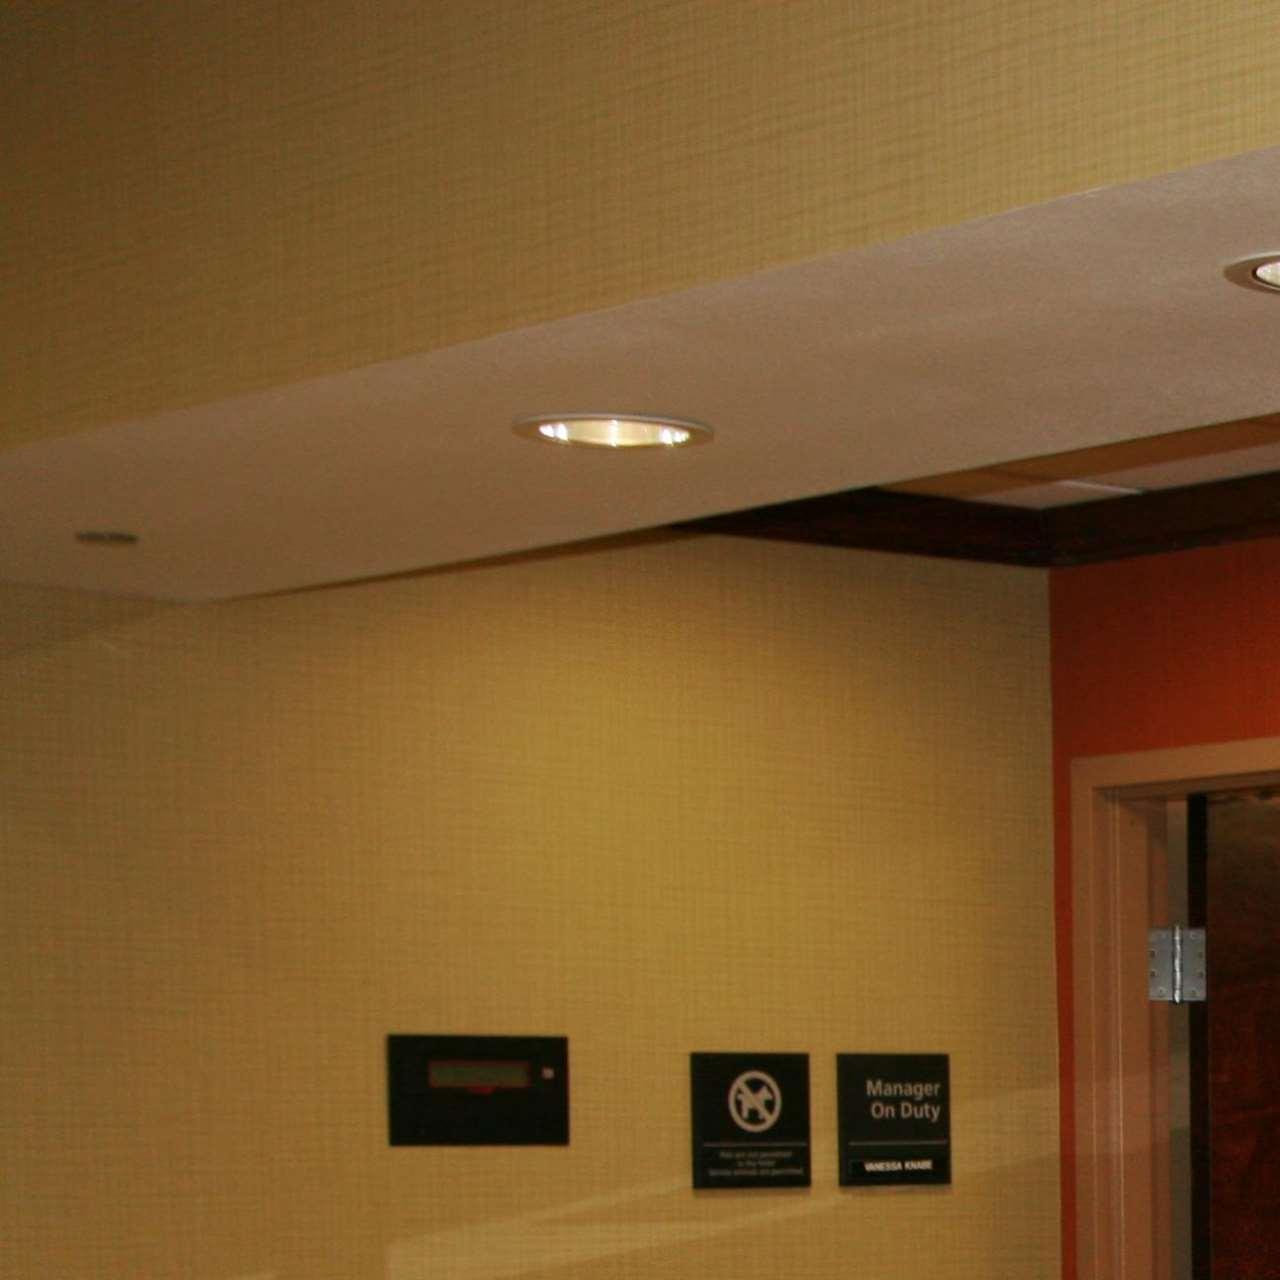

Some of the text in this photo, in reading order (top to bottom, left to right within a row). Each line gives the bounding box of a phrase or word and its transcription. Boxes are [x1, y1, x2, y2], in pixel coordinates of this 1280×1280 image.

[866, 1079, 941, 1101] Manager
[871, 1102, 941, 1123] On Duty
[864, 1161, 903, 1172] VANESSA
